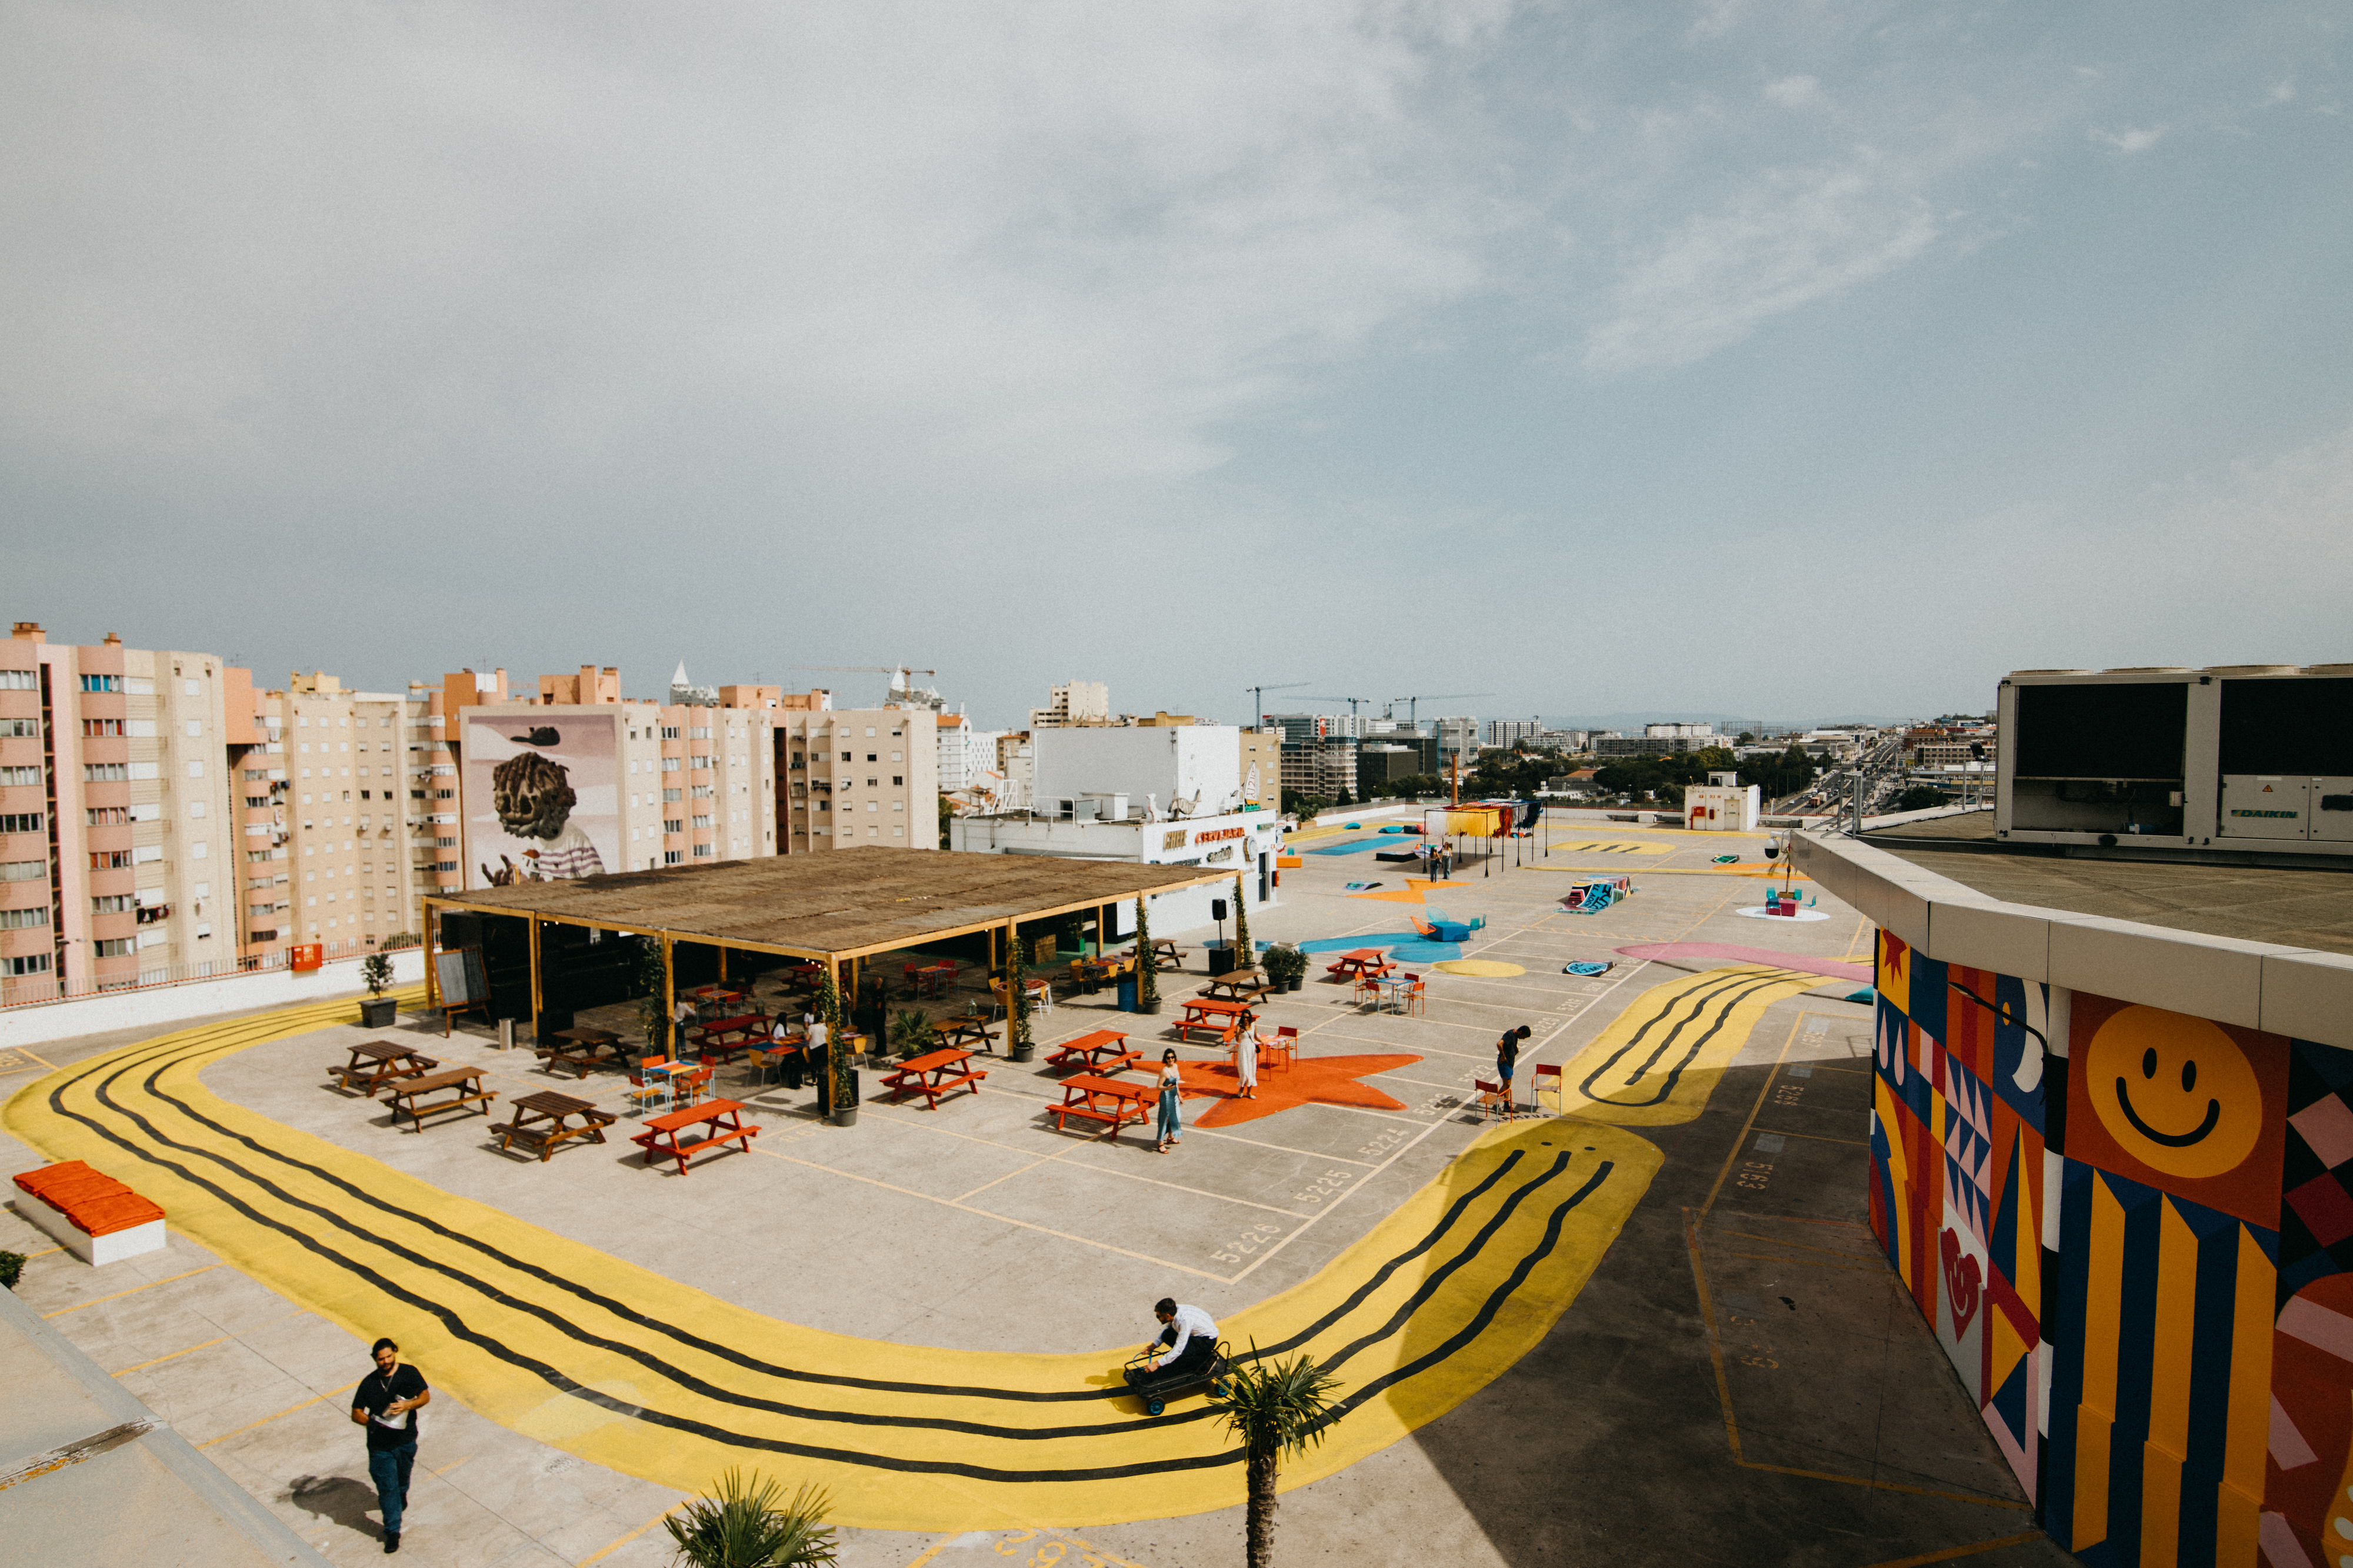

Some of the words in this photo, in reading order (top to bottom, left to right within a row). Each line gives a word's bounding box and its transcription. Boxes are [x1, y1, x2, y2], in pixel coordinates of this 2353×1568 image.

[2241, 810, 2298, 818] DAIKIN
[1195, 826, 1245, 843] CERVEJARIA
[1529, 1017, 1560, 1033] 5220
[1774, 1085, 1804, 1106] 5266
[1358, 1127, 1411, 1157] 5224
[1293, 1170, 1353, 1203] 5225
[1737, 1162, 1774, 1190] 5163
[1210, 1223, 1282, 1264] 5226
